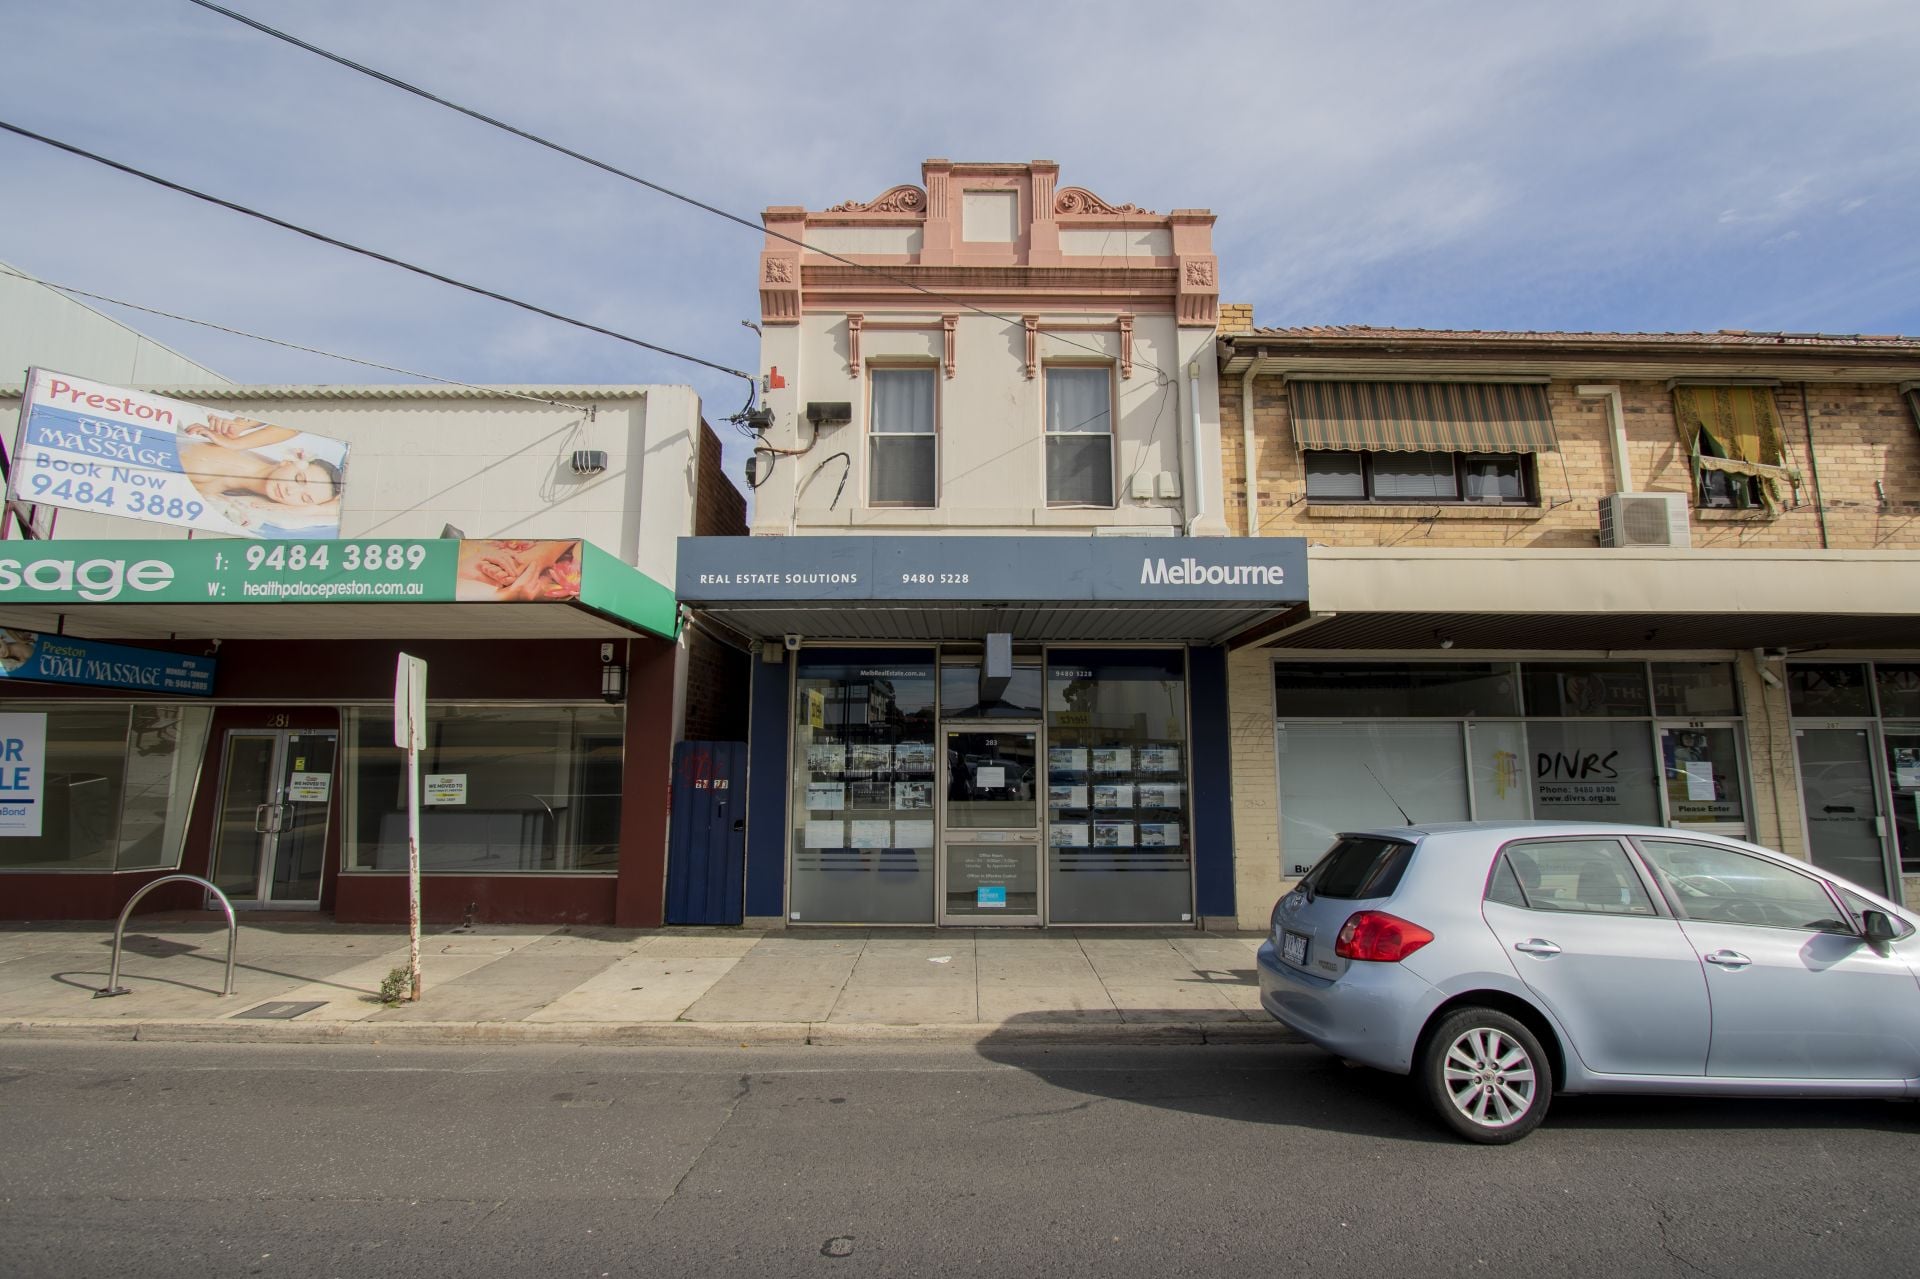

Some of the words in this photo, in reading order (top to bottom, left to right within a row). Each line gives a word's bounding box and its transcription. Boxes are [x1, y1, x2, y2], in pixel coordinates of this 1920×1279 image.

[49, 378, 173, 425] Preston
[78, 417, 142, 445] THAI
[39, 426, 172, 469] MASSAGE
[36, 452, 101, 478] Book
[111, 465, 167, 490] Now
[31, 474, 115, 508] 9484
[126, 491, 204, 521] 3889
[246, 544, 329, 571] 9484
[342, 544, 426, 571] 3889
[0, 558, 174, 602] sage
[699, 573, 731, 584] REAL
[735, 573, 780, 584] ESTATE
[785, 573, 858, 584] SOLUTIONS
[902, 573, 935, 584] 9480
[939, 573, 969, 584] 5228
[1140, 558, 1284, 586] Melbourne
[243, 580, 424, 599] healthpalacepreston.com.au
[42, 642, 86, 657] Preston
[40, 654, 83, 678] THAI
[85, 660, 161, 687] MASSAGE
[860, 669, 926, 677] MelbRealEstate.com.au
[267, 714, 289, 728] 281
[1537, 748, 1618, 780] DIVRS
[1678, 805, 1705, 813] Please
